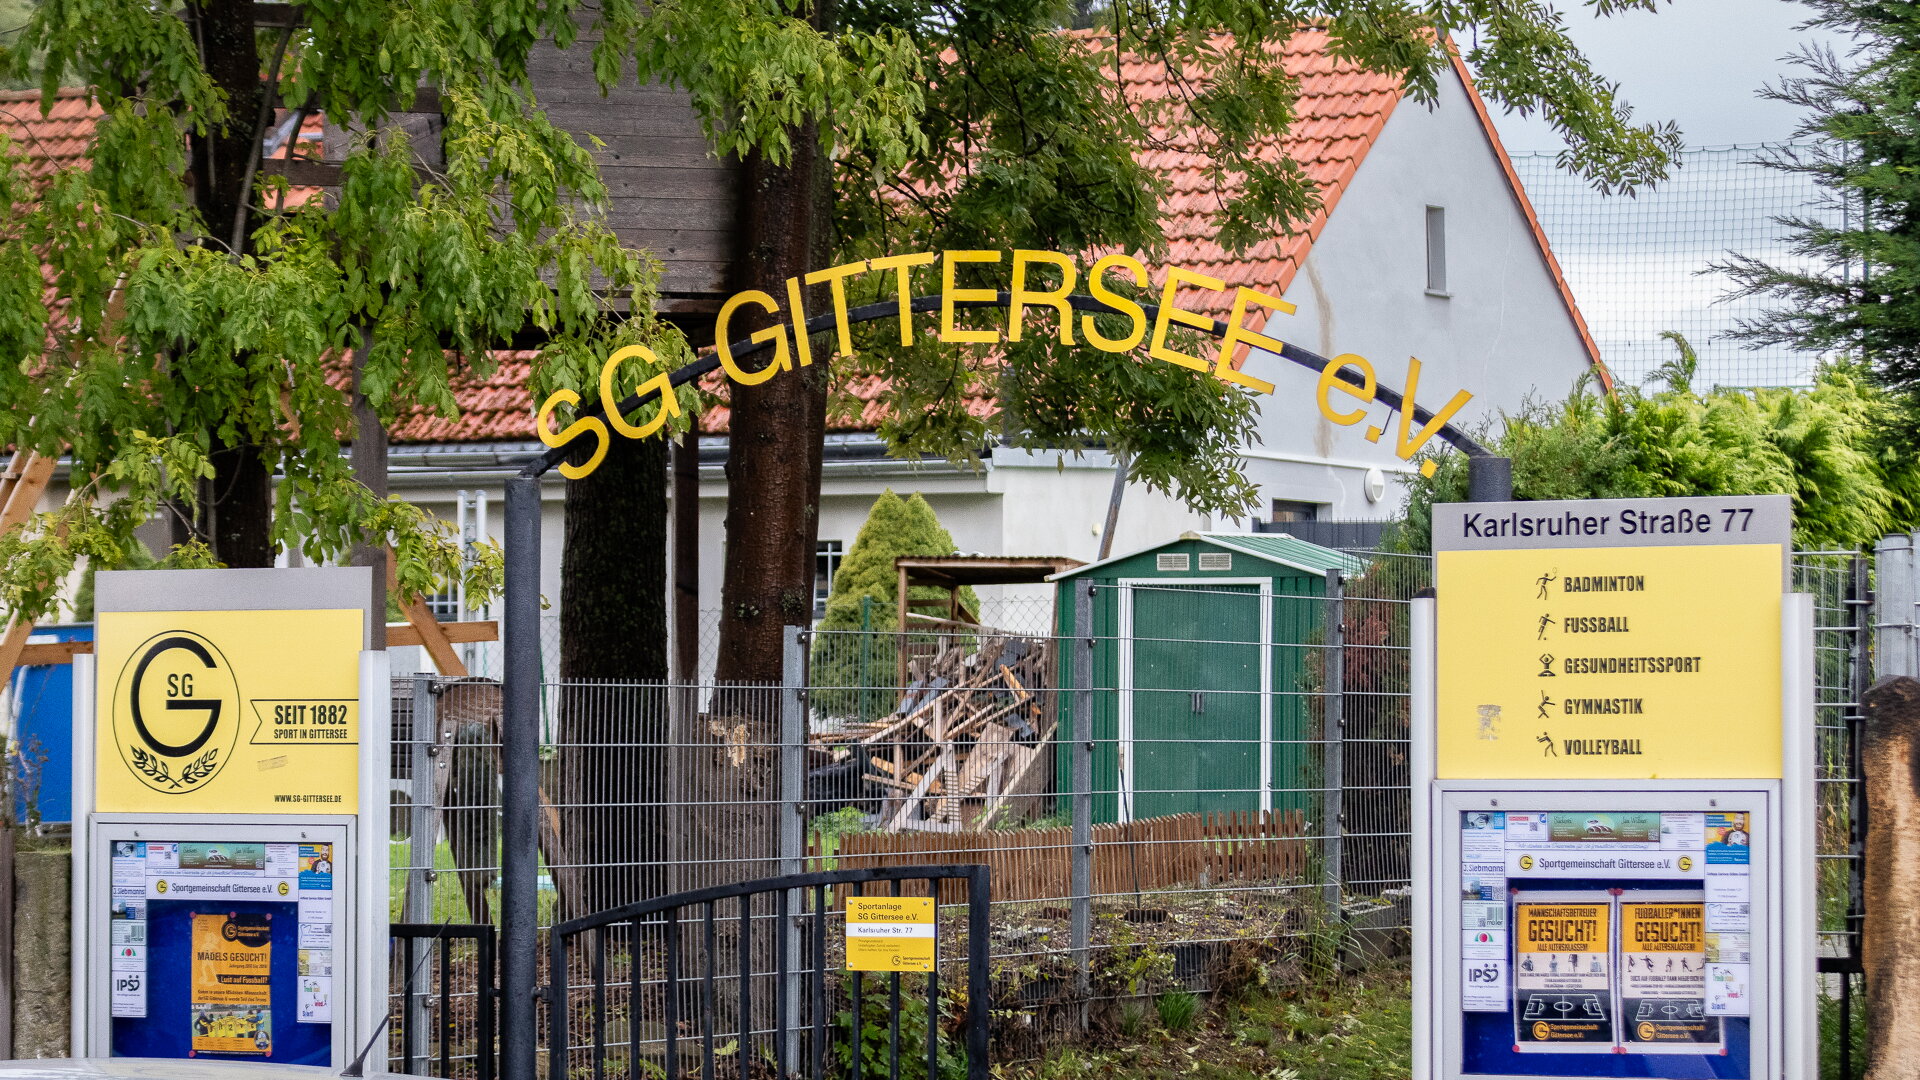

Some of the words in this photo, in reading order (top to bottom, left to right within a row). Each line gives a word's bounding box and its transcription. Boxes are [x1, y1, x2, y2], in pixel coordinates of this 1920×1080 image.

[538, 344, 680, 480] SG
[714, 249, 1298, 394] GITTERSEE
[1316, 353, 1473, 479] e.V.
[1463, 510, 1609, 538] Karlsruher
[1619, 508, 1711, 534] Straße
[1720, 508, 1754, 532] 77
[1564, 575, 1645, 593] BADMINTON
[1564, 616, 1629, 633] FUSSBALL
[1563, 656, 1701, 674] GESUNDHEITSSPORT
[166, 673, 193, 697] SG
[274, 705, 307, 725] SEIT
[310, 704, 348, 725] 1882
[1563, 697, 1643, 715] GYMNASTIK
[273, 729, 298, 739] SPORT
[299, 729, 308, 739] IN
[309, 729, 348, 739] GITTERSEE
[1563, 738, 1643, 755] VOLLEYBALL
[274, 795, 342, 803] WWW.SG-GITTERSEE.DE
[1539, 858, 1616, 870] Sportgemeinschaft
[1618, 859, 1655, 869] Gittersee
[1656, 859, 1671, 869] e.V.
[171, 882, 231, 893] Sportgemeinschaft
[232, 884, 261, 894] Gittersee
[262, 885, 273, 894] e.V.
[858, 903, 902, 911] Sportanlage
[1528, 908, 1597, 918] MANNSCHAFTSBETREUER
[1528, 919, 1597, 942] GESUCHT!
[1635, 921, 1701, 942] GESUCHT!
[197, 950, 228, 961] MÄDELS
[229, 952, 267, 962] GESUCHT!
